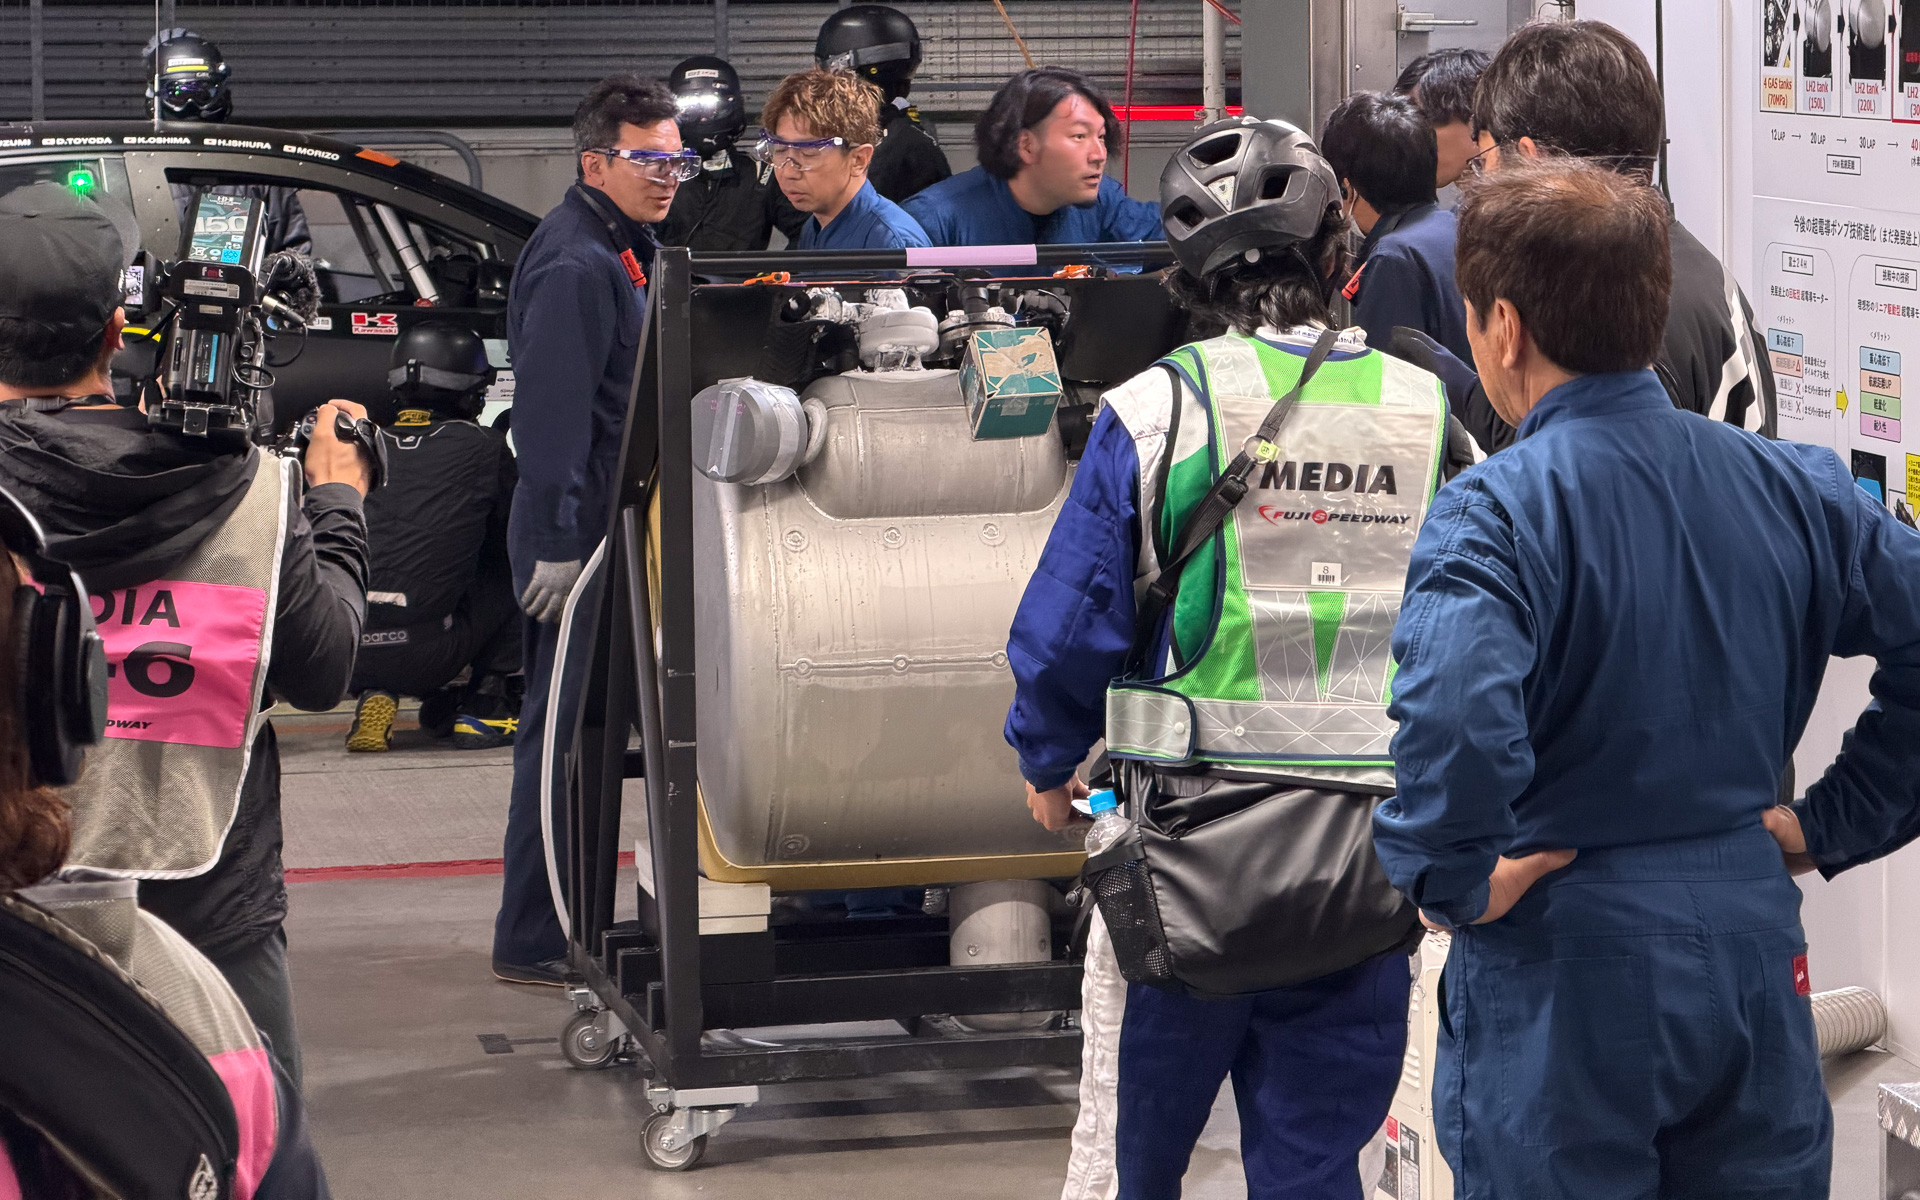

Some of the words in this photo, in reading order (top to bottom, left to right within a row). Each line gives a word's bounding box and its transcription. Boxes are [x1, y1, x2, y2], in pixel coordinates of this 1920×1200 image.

[1768, 78, 1778, 89] GAS
[1778, 78, 1792, 90] tanks
[1806, 80, 1815, 92] LH2
[1816, 80, 1828, 93] tank
[1854, 82, 1865, 94] LH2
[1866, 82, 1879, 95] tank
[1857, 98, 1875, 114] (220L)
[56, 137, 112, 145] D.TOYODA
[217, 139, 271, 150] H.ISHIURA
[297, 147, 340, 161] MORIZO
[1259, 460, 1397, 495] MEDIA
[1273, 511, 1310, 521] FUJI
[1312, 509, 1411, 525] SPEEDWAY
[1323, 566, 1329, 574] 8
[89, 589, 180, 628] DIA
[362, 630, 407, 643] parco
[105, 719, 153, 730] DWAY
